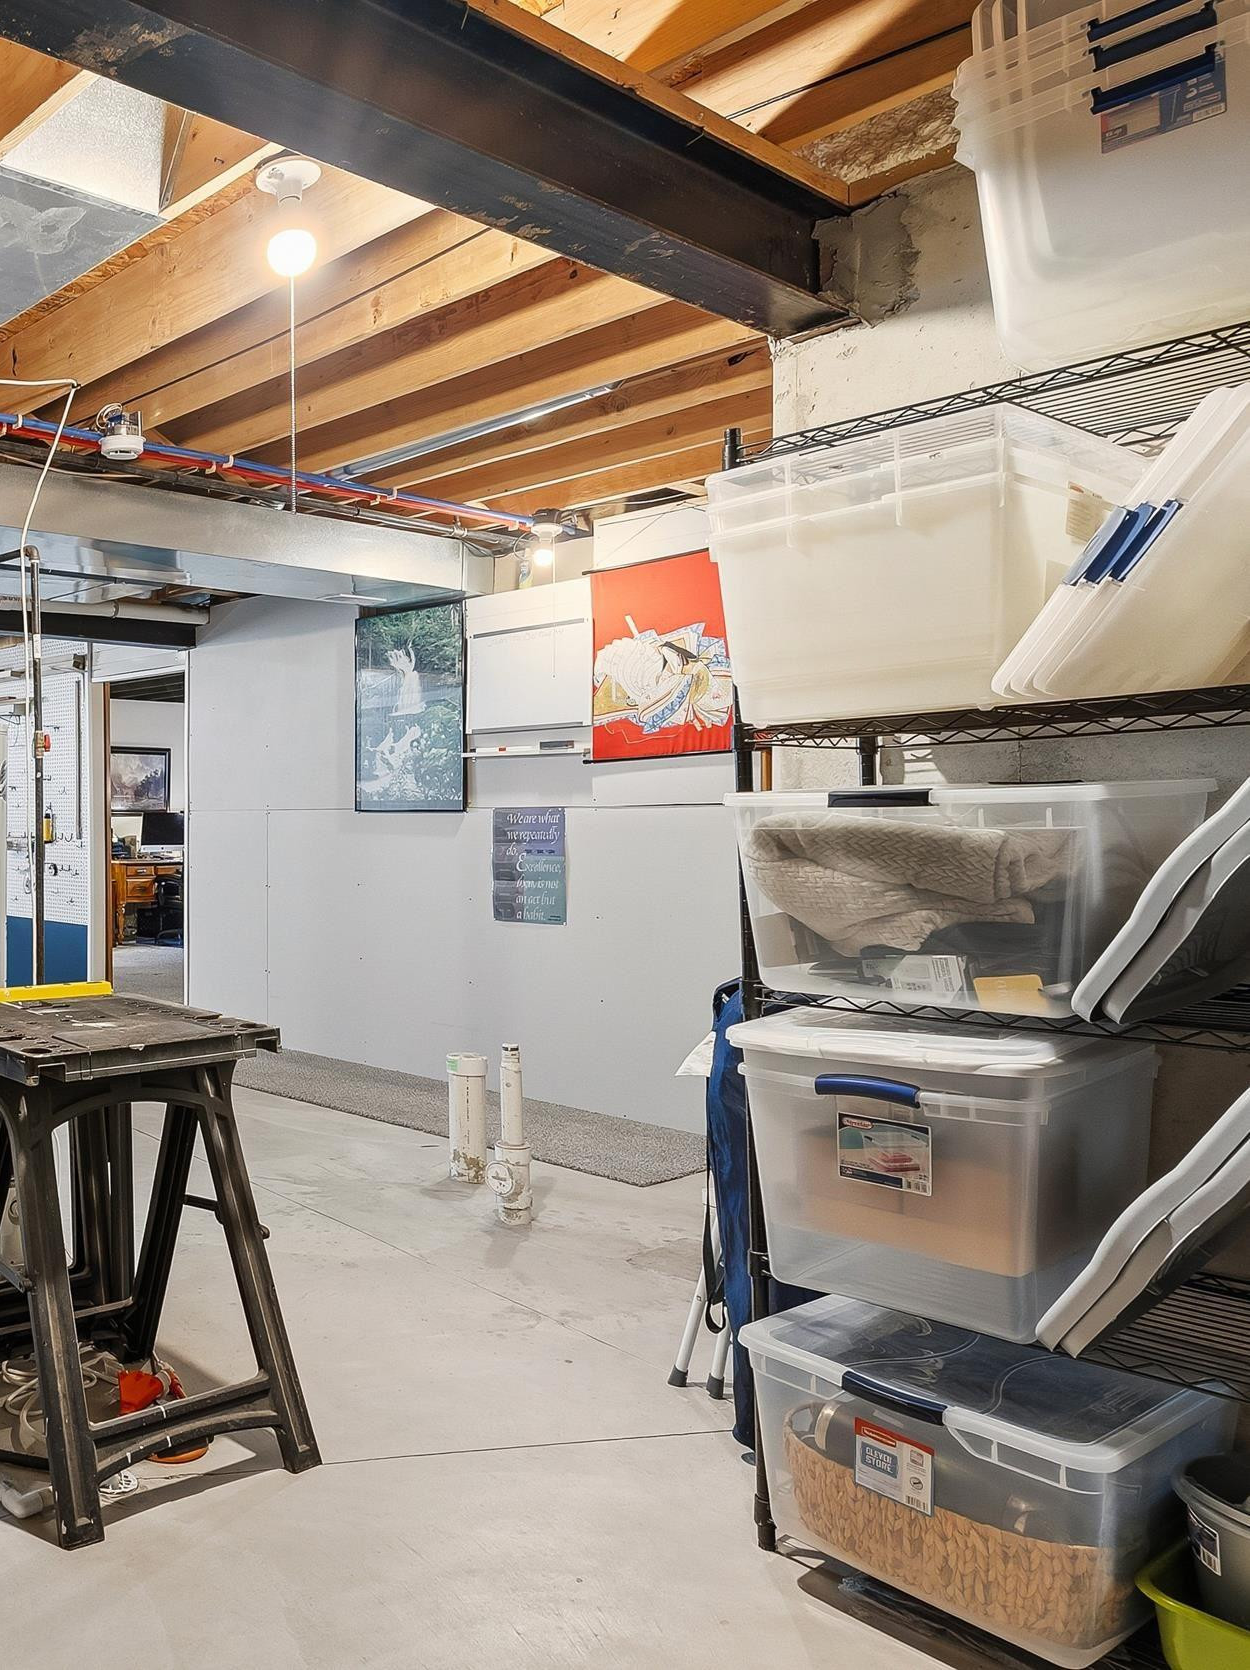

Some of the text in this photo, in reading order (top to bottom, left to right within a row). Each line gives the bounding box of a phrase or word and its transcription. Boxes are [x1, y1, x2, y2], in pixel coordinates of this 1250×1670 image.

[506, 809, 560, 824] We are what
[506, 831, 518, 840] we
[516, 911, 522, 920] a
